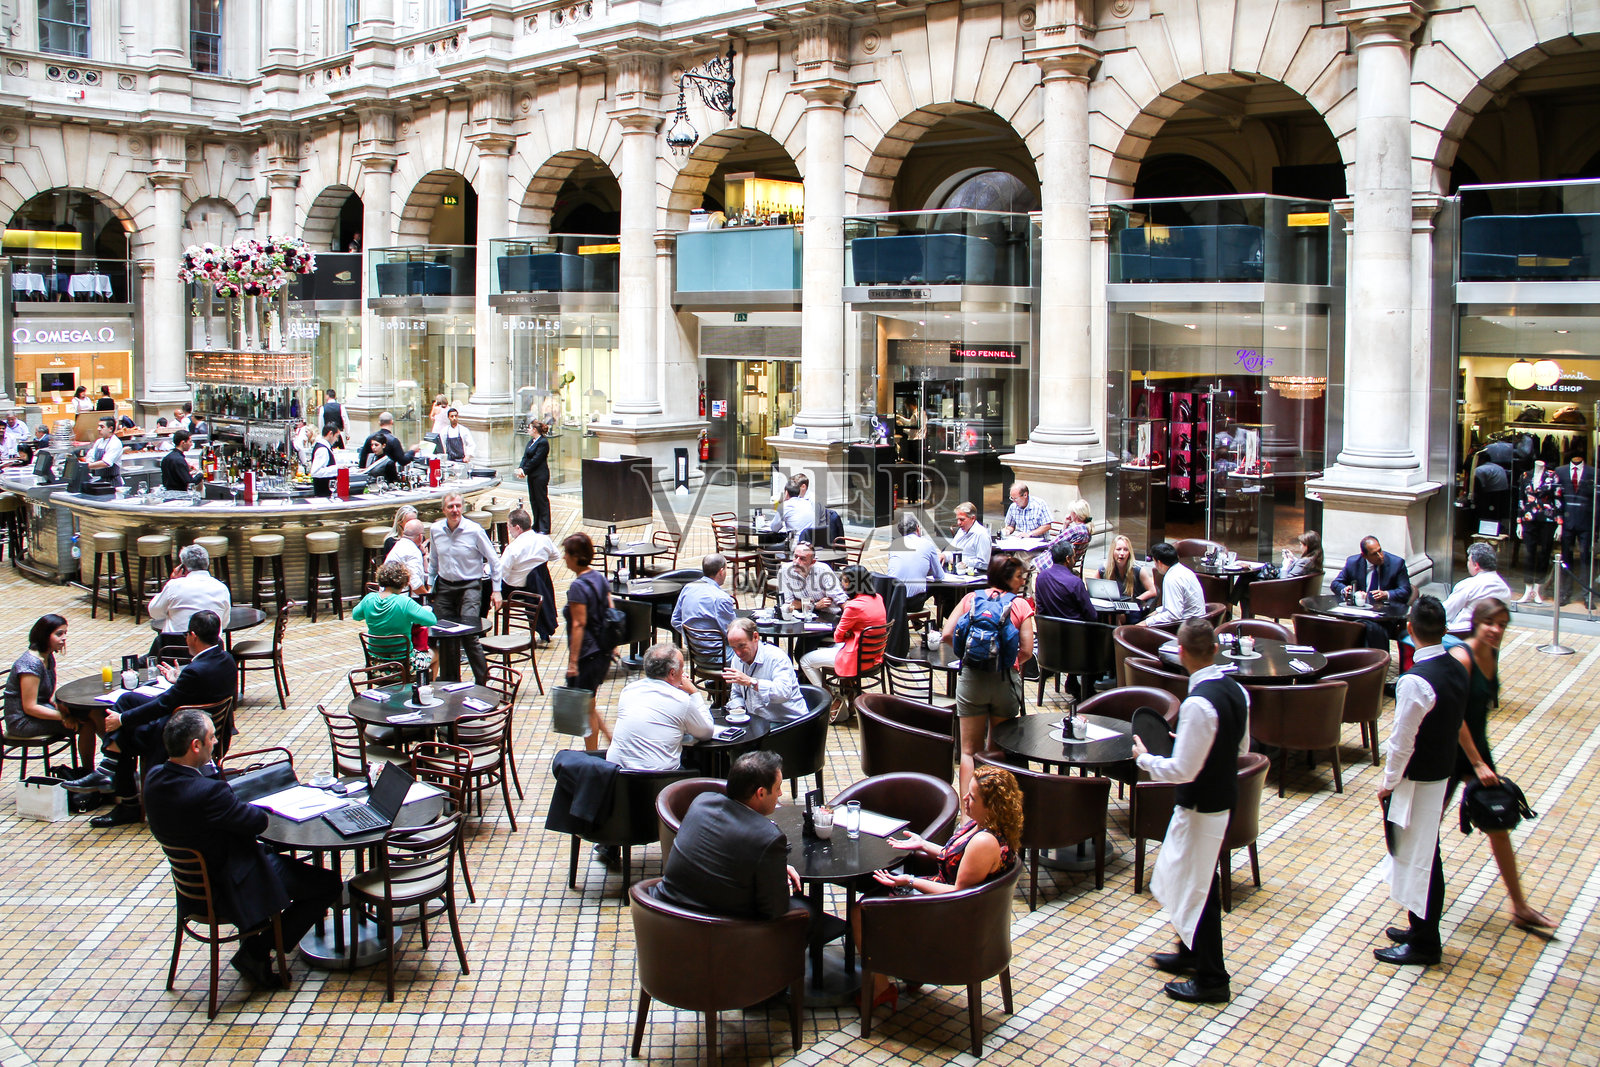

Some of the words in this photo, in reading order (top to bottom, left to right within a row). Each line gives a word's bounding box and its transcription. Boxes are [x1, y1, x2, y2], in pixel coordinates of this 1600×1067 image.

[503, 321, 560, 330] BOODLES
[35, 329, 94, 344] OMEGA
[956, 349, 977, 357] THEO
[978, 350, 1016, 358] FENNELL
